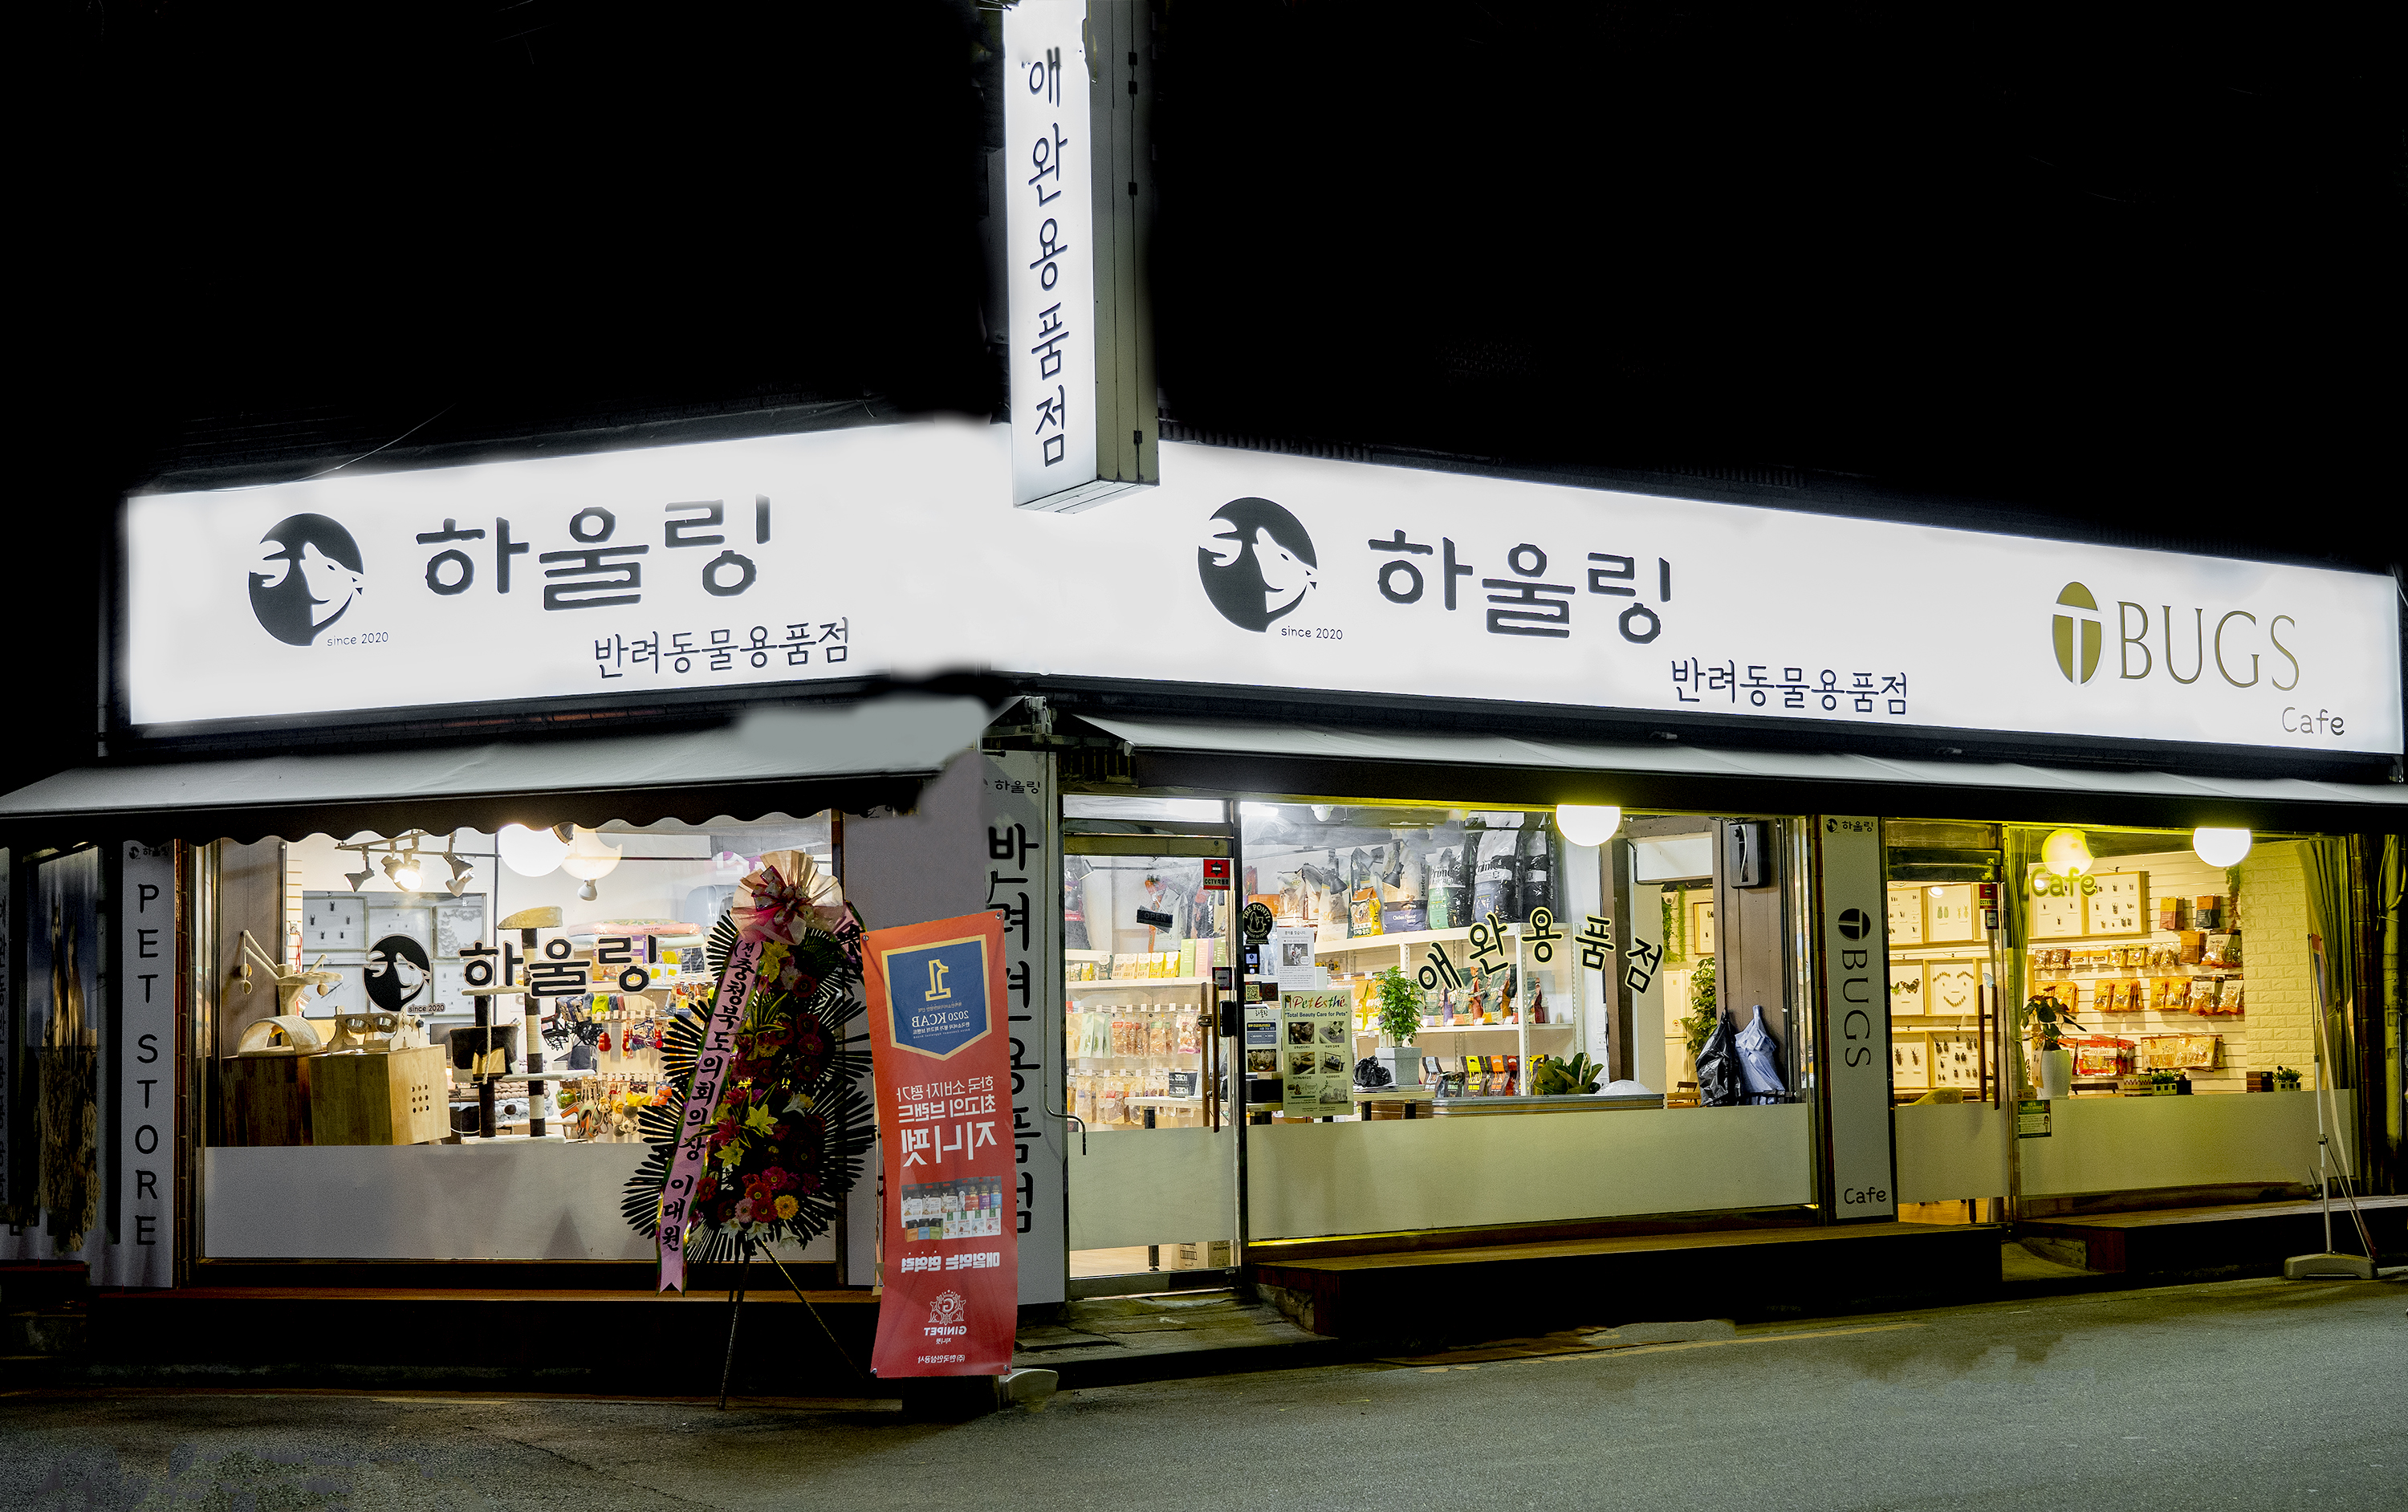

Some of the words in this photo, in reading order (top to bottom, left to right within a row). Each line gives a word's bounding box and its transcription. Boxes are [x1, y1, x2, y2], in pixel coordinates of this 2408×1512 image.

[1028, 47, 1068, 468] 애완용품점
[416, 493, 771, 612] 하울링
[1367, 529, 1671, 645] 하울링
[327, 634, 357, 647] since
[361, 632, 389, 645] 2020
[594, 616, 851, 680] 반려동물용품점
[1281, 625, 1312, 639] since
[1316, 628, 1344, 640] 2020
[1670, 656, 1910, 716] 반려동물용품점
[2281, 706, 2345, 737] Cafe
[995, 778, 1041, 795] 하울링
[1841, 820, 1873, 832] 하울링
[2031, 867, 2097, 897] Cafe
[137, 884, 160, 1003] PET
[1144, 912, 1167, 921] OPEN
[458, 934, 658, 999] 하울링
[1418, 907, 1664, 994] 애완용품점
[407, 1003, 426, 1013] since
[428, 1002, 446, 1013] 2020
[1841, 948, 1872, 1067] BUGS
[135, 1034, 159, 1246] STORE
[1844, 1186, 1887, 1205] Cafe
